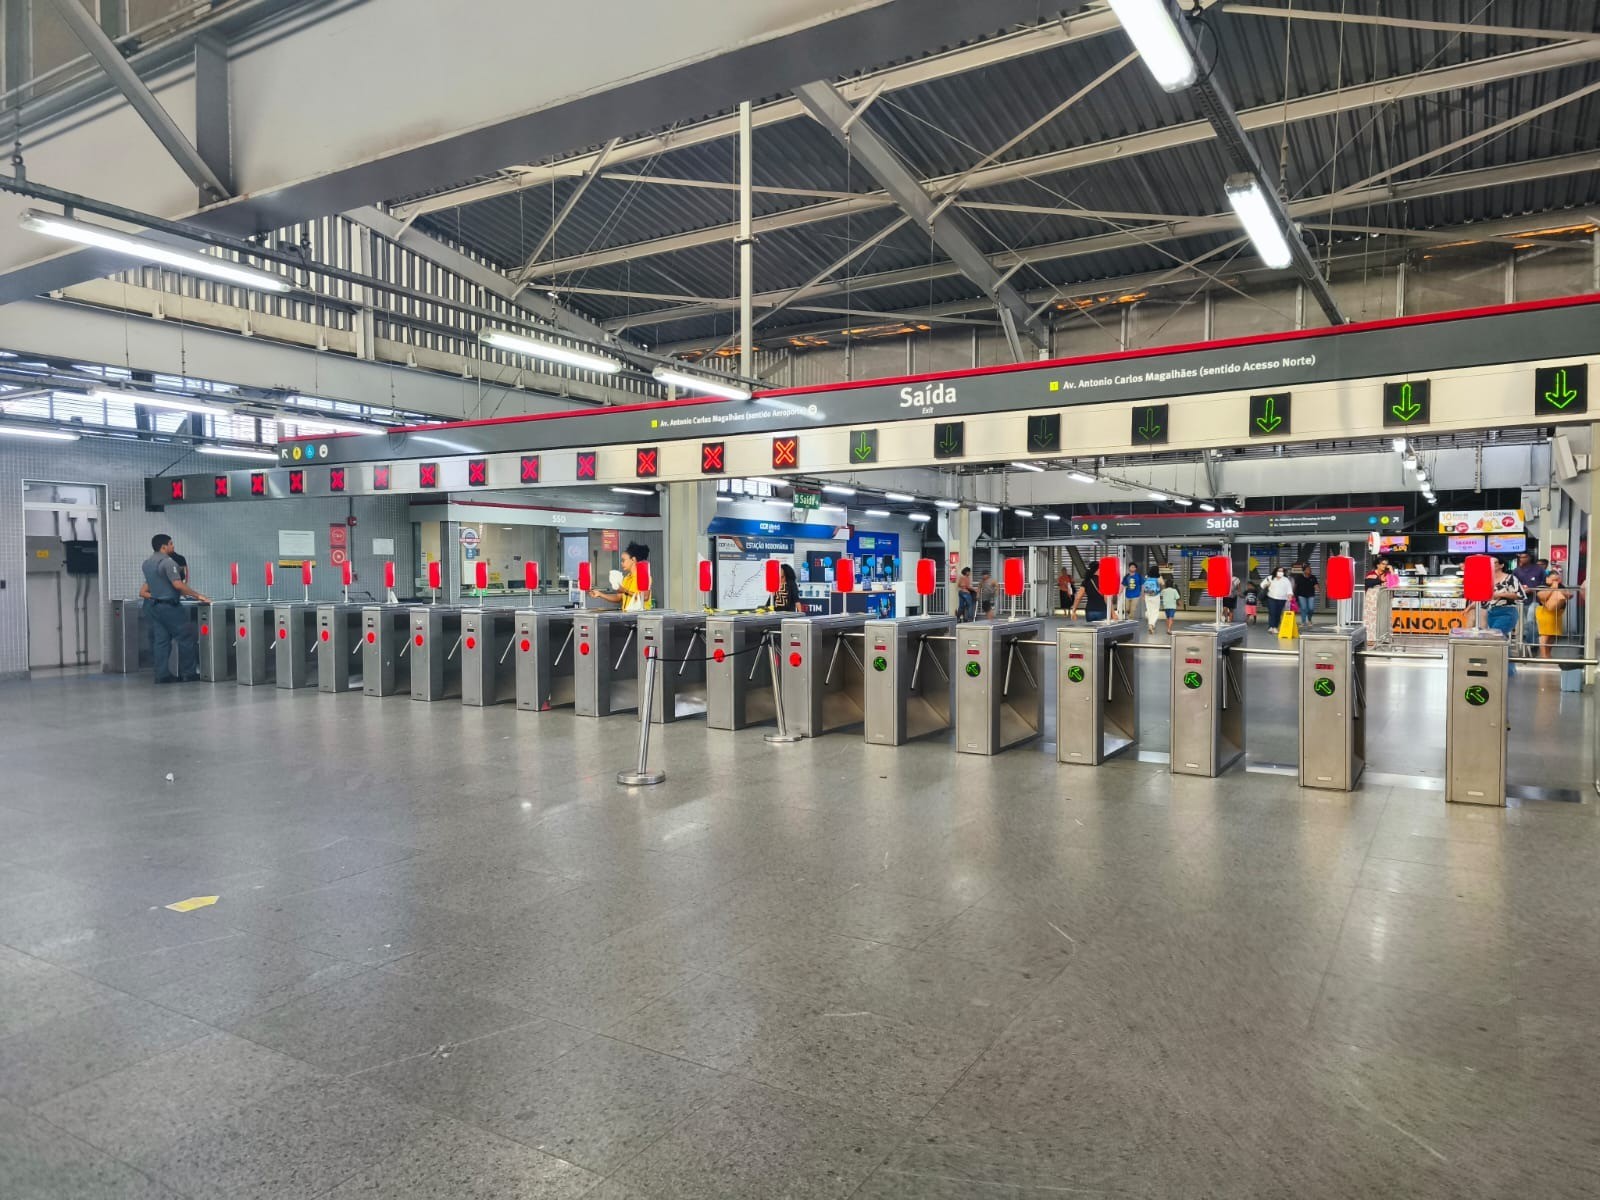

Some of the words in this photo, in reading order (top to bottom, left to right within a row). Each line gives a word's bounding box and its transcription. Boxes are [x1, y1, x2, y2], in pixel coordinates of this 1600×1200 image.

[1062, 381, 1077, 390] Av.
[1078, 377, 1113, 388] Antonio
[1114, 375, 1143, 385] Carlos
[1145, 369, 1198, 382] Magalhães
[1199, 363, 1241, 377] (sentido
[1242, 360, 1280, 372] Acesso
[1282, 354, 1316, 368] Norte)
[900, 383, 957, 408] Saída
[921, 406, 934, 415] Exit
[660, 419, 670, 428] Av.
[670, 417, 692, 427] Antonio
[693, 416, 712, 425] Carlos
[712, 412, 745, 425] Magalhães
[1206, 517, 1240, 529] Saída
[808, 604, 823, 612] TIM
